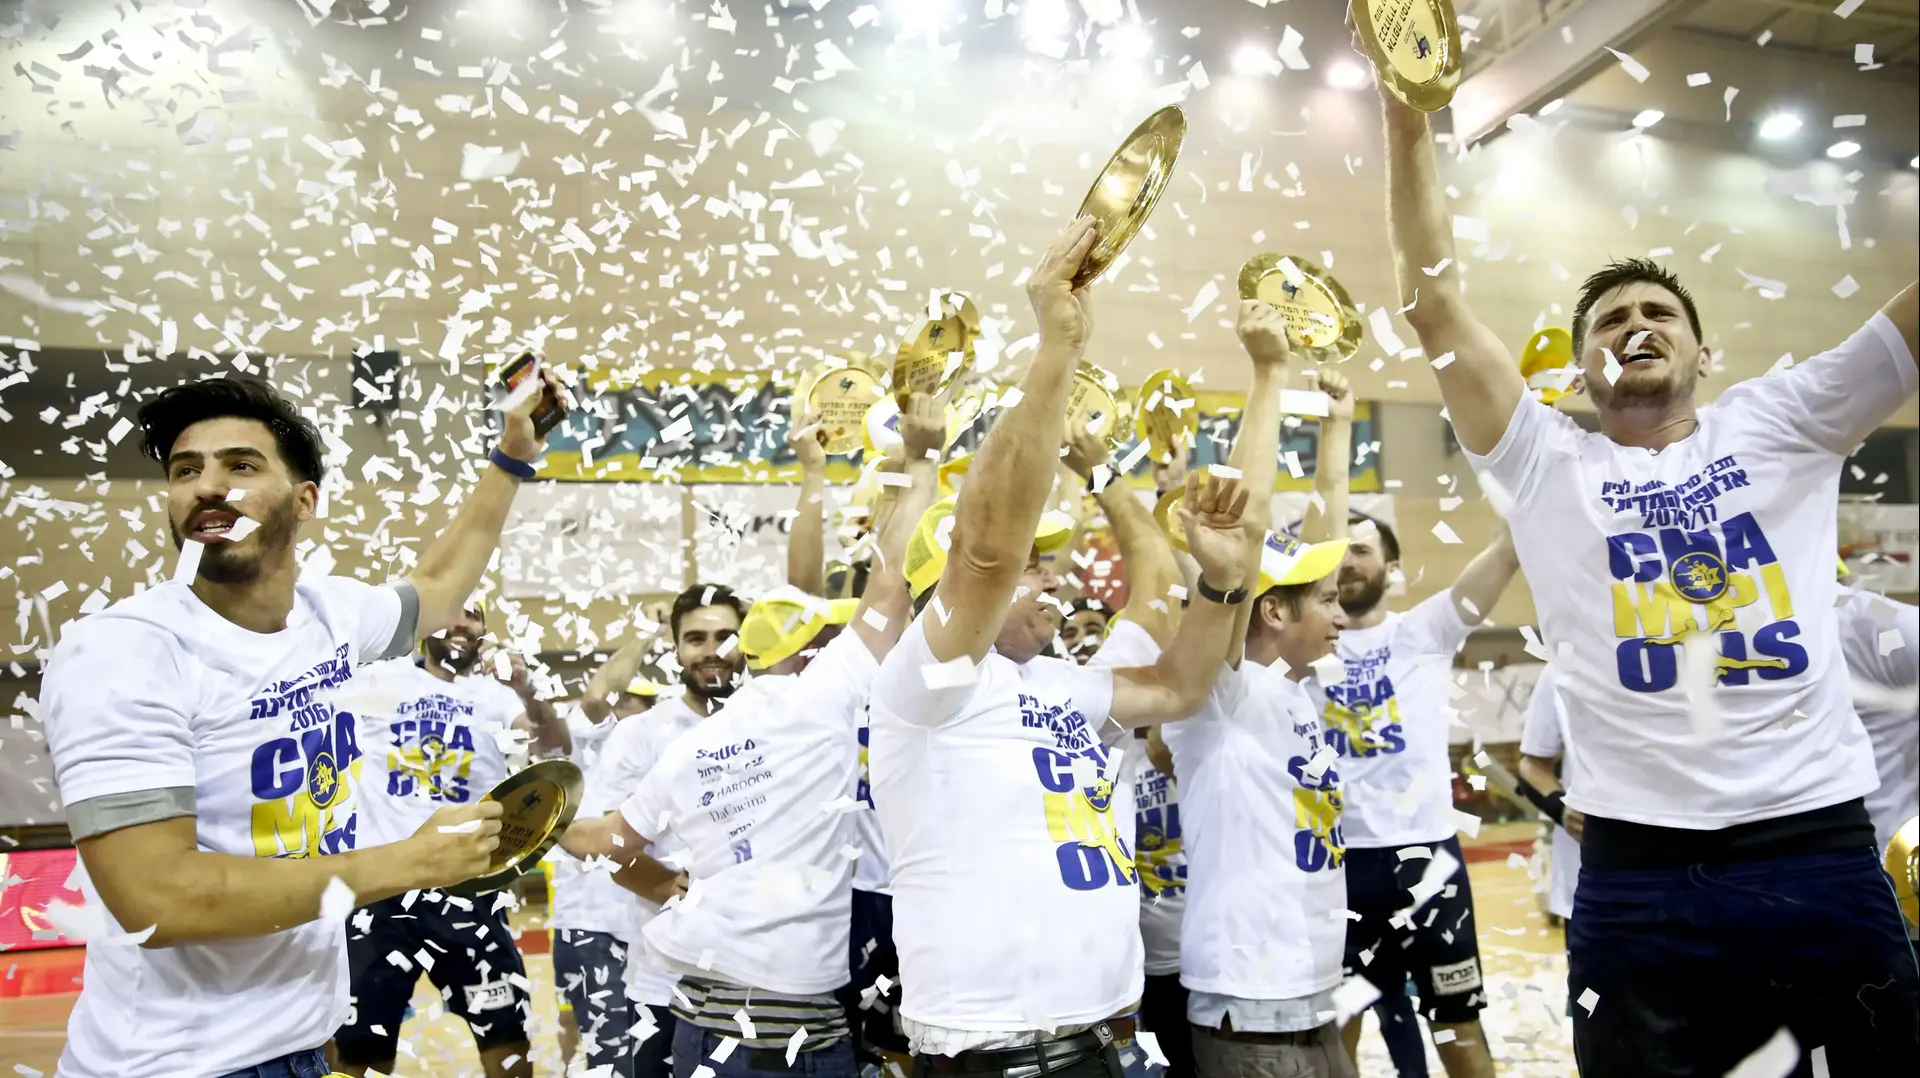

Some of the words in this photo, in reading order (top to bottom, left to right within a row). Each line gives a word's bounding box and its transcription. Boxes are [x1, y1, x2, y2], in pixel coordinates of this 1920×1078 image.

[1386, 20, 1403, 53] אלופת
[1399, 0, 1414, 22] המדי
[1642, 503, 1718, 531] 2016/17
[1607, 511, 1778, 584] CHA
[1325, 675, 1396, 708] CHA
[390, 719, 475, 753] CHA
[250, 710, 363, 800] CHA
[708, 794, 768, 824] DaCucina
